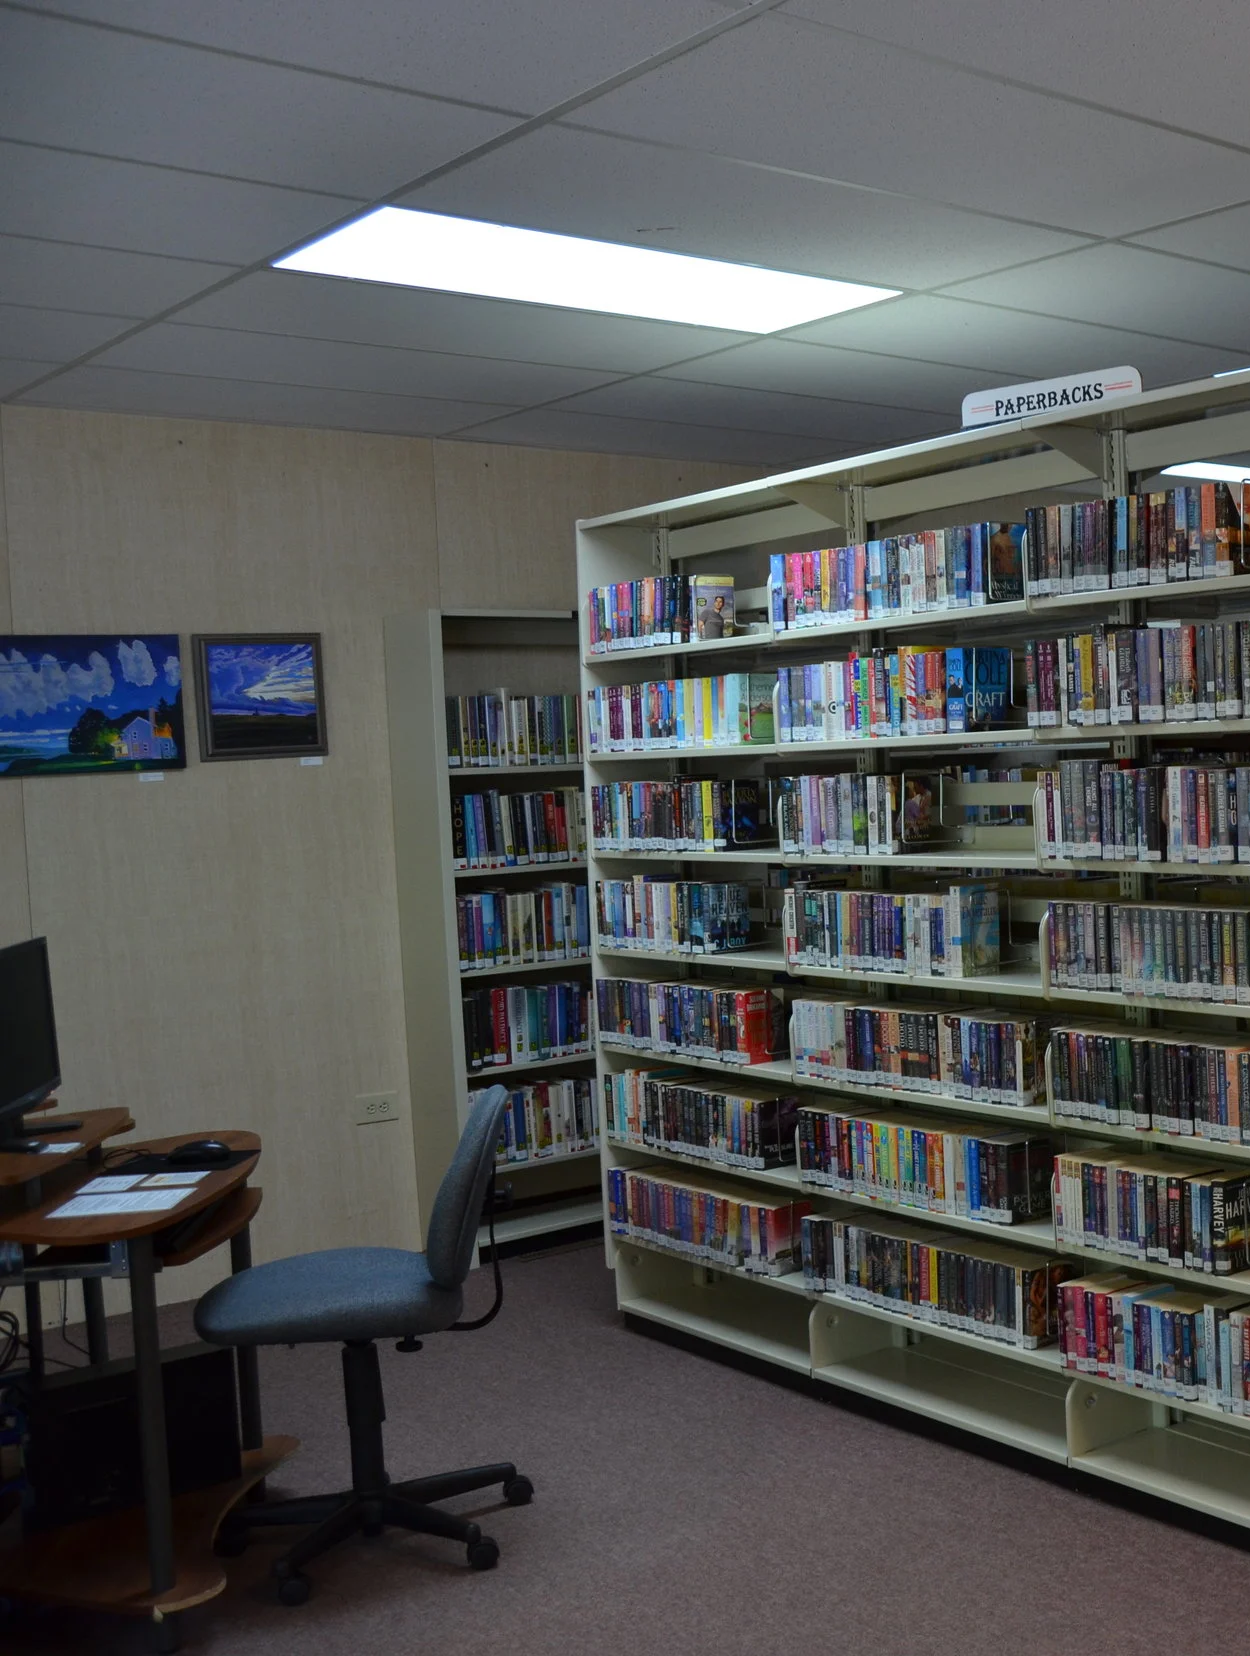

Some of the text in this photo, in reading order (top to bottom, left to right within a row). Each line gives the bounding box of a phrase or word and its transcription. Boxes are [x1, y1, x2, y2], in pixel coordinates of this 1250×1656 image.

[994, 383, 1104, 417] PAPERBACKS
[874, 658, 884, 698] HARLAN COBEN
[965, 691, 1006, 708] CRAFT
[711, 901, 748, 915] HEAVEN
[1212, 1193, 1225, 1234] HARVEY
